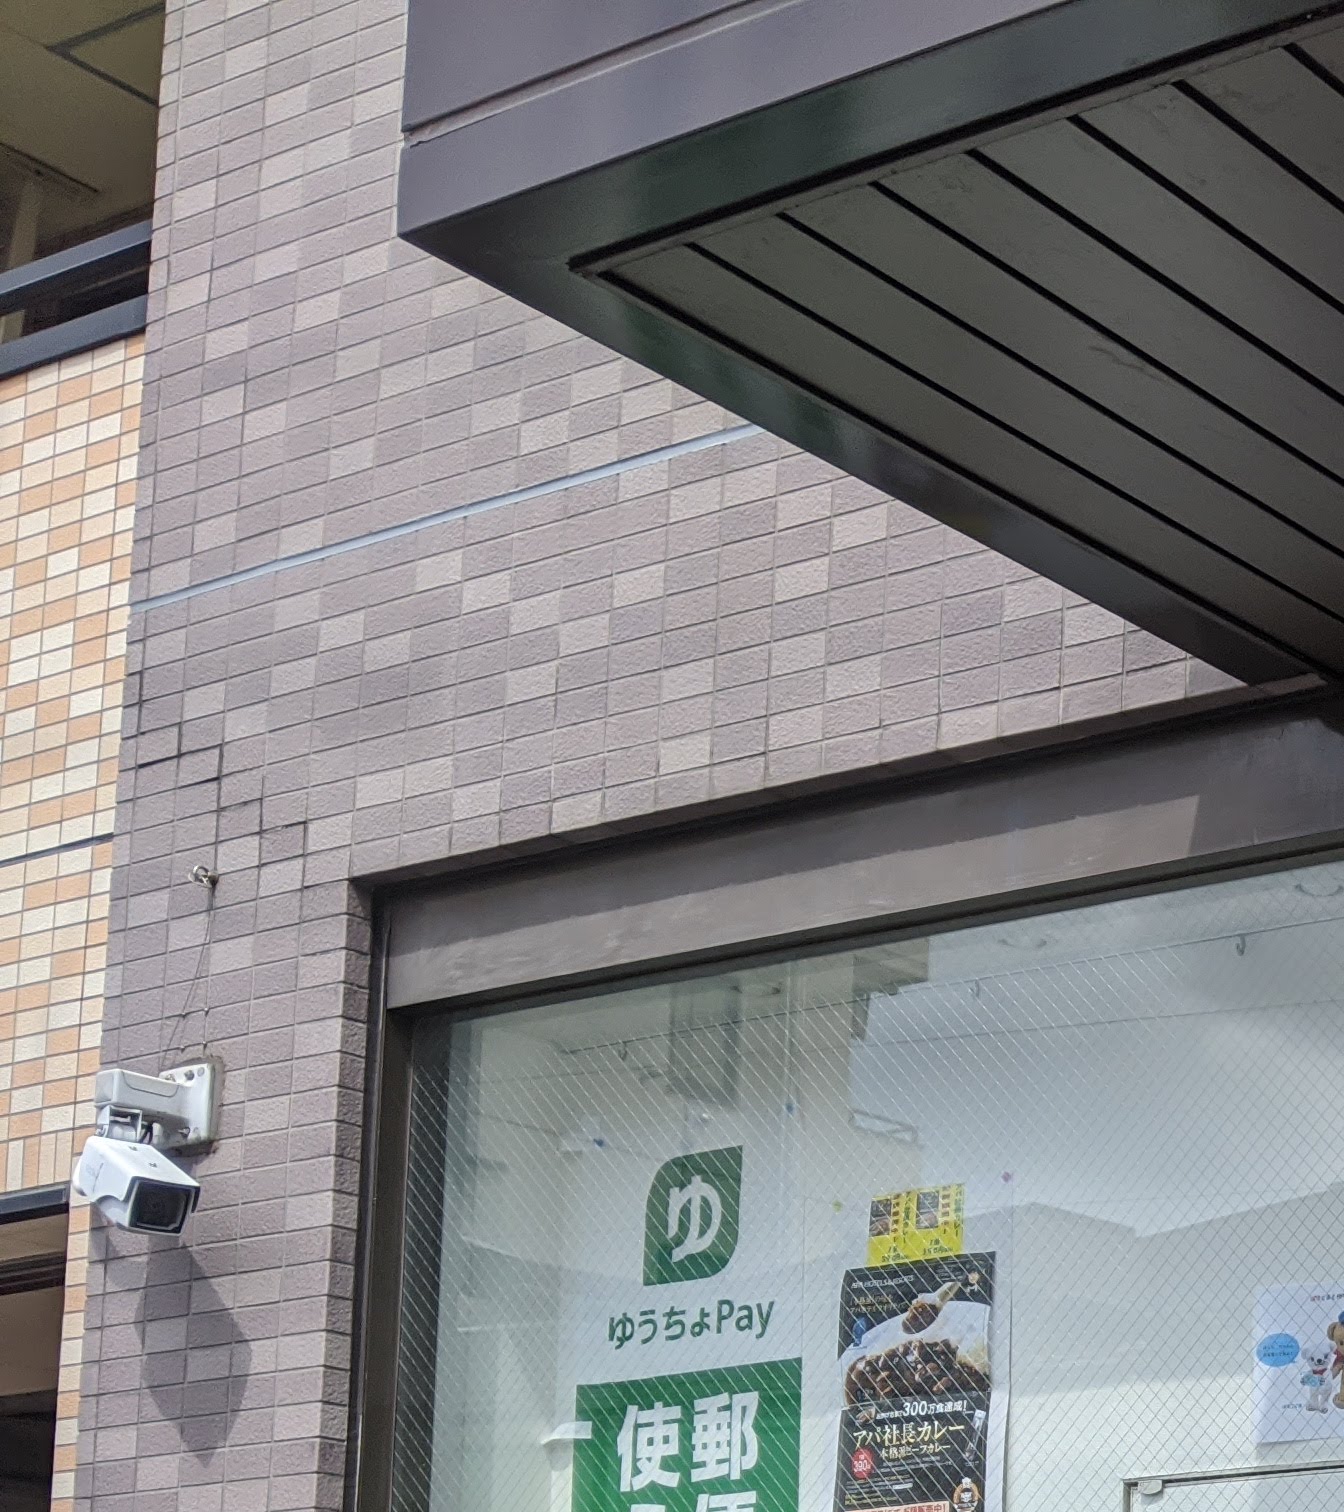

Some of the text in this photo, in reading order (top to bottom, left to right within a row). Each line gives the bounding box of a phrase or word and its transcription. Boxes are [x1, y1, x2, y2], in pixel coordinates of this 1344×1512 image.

[607, 1299, 775, 1350] ゆうちょPay
[853, 1421, 965, 1449] アパ社長カレー
